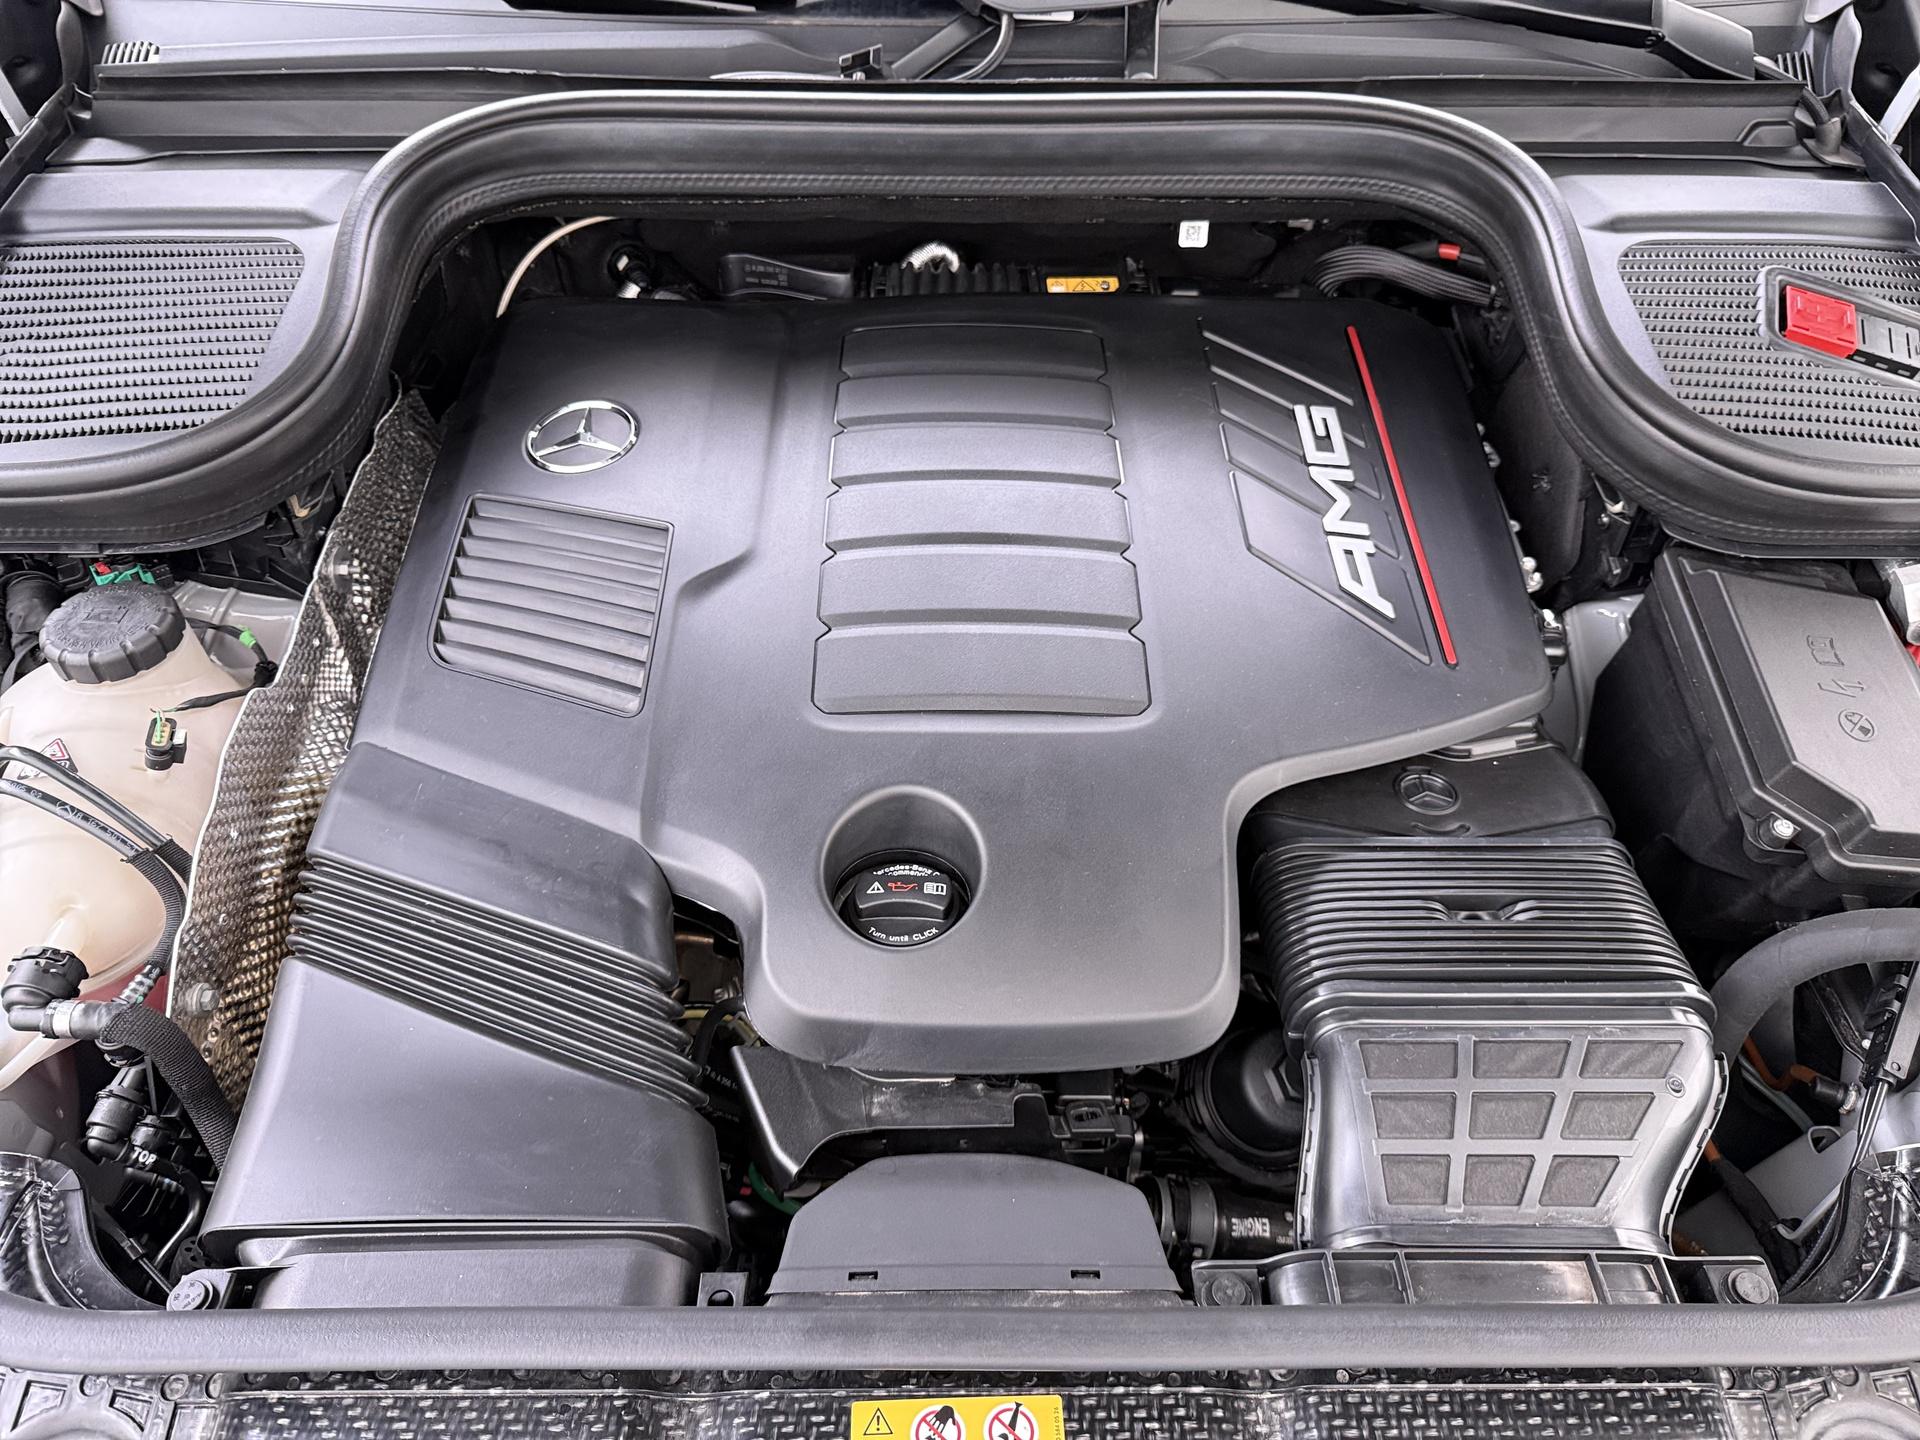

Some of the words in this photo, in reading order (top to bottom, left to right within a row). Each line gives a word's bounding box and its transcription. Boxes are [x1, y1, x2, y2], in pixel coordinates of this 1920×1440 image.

[1293, 404, 1396, 619] AMG
[868, 926, 887, 940] Turn
[889, 934, 909, 942] until
[912, 926, 939, 941] CLICK
[132, 1146, 157, 1165] TOP
[1231, 1216, 1271, 1238] ENGINE
